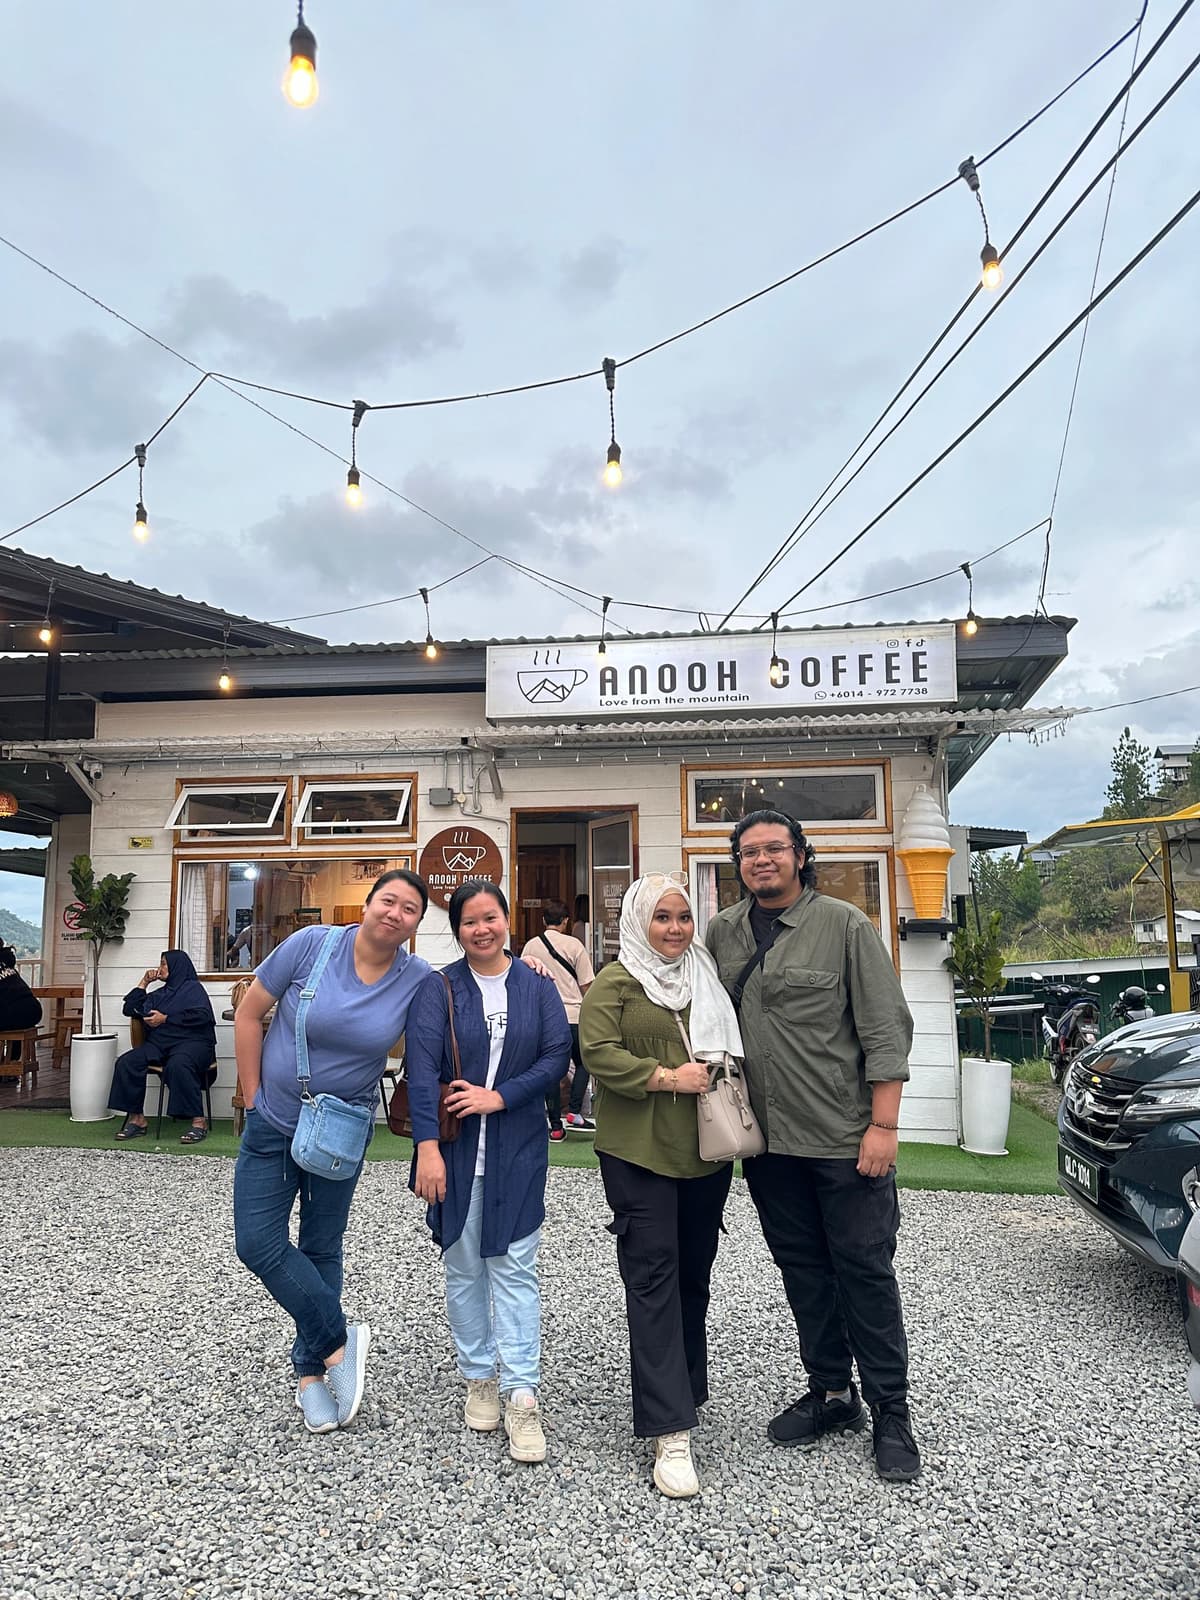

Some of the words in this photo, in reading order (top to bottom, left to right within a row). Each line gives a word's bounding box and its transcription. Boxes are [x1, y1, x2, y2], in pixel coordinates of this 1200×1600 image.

[600, 661, 737, 696] ANOOH
[829, 690, 863, 698] +6014
[876, 689, 896, 697] 972
[900, 687, 928, 696] 7738
[632, 697, 660, 705] from
[665, 696, 685, 704] the
[689, 693, 750, 704] mountain
[428, 874, 457, 885] ANOOH
